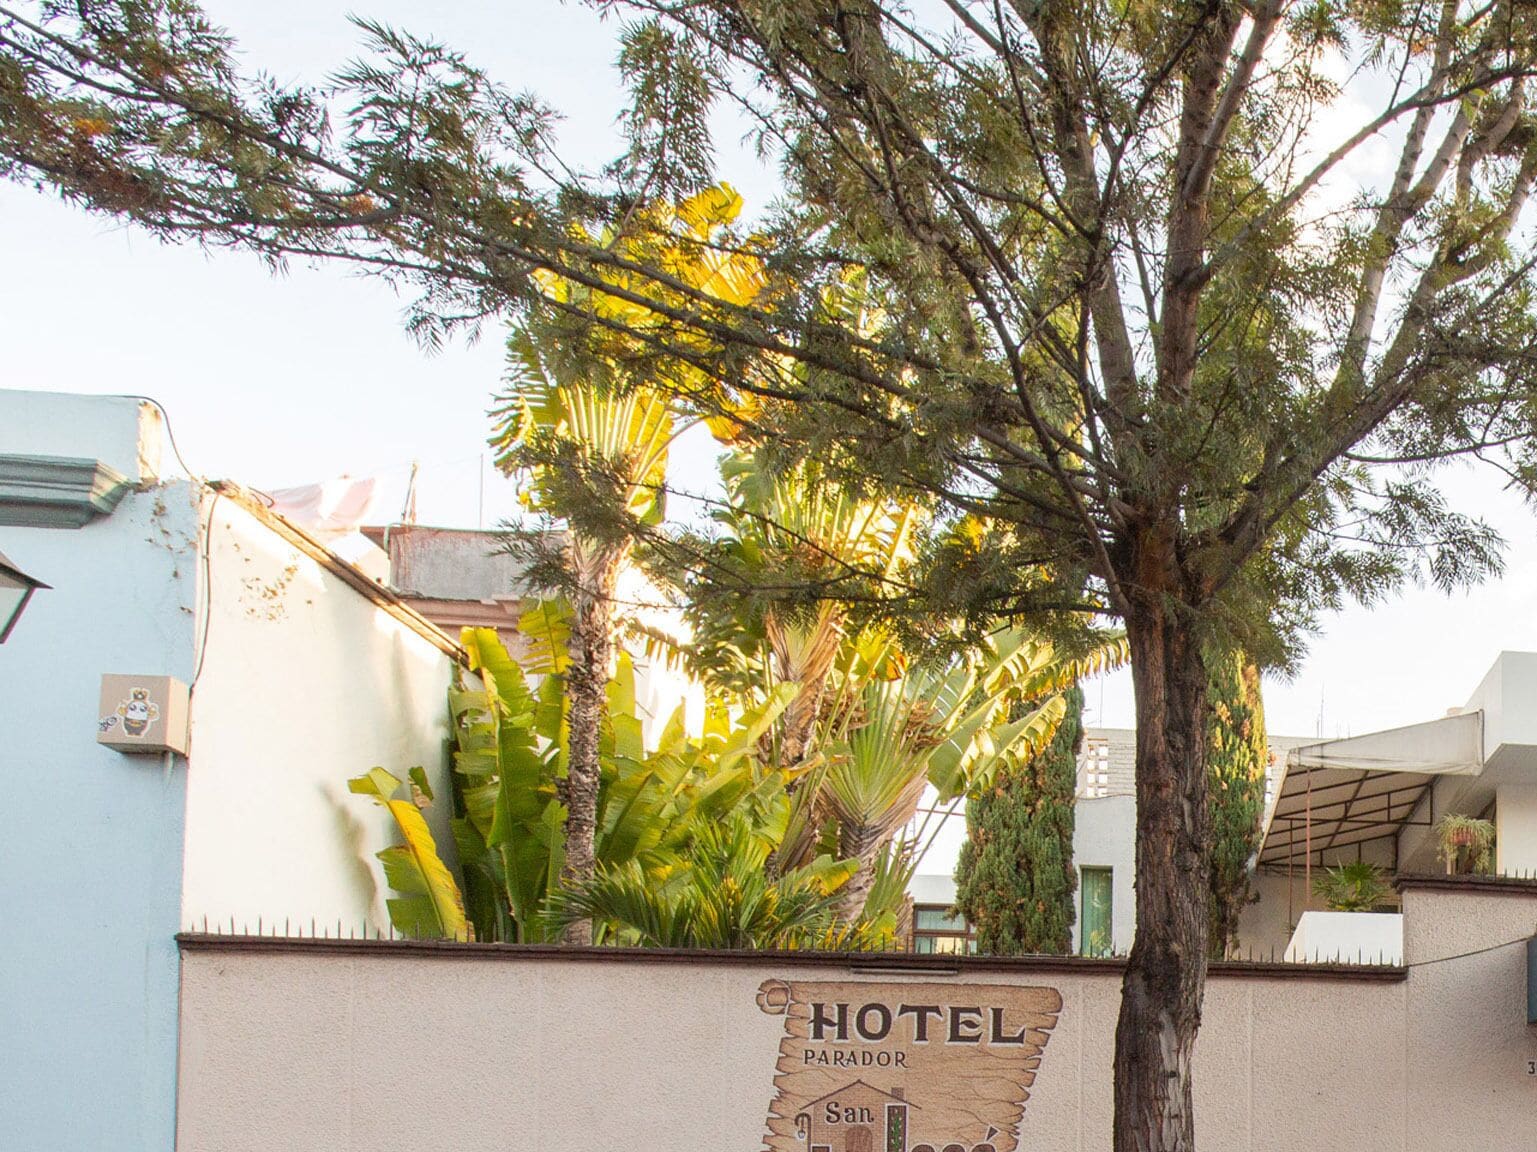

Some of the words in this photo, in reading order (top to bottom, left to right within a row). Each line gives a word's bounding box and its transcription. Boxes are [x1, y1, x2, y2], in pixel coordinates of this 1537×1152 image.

[808, 1002, 1026, 1044] HOTEL
[803, 1049, 909, 1068] PARADOR
[825, 1102, 875, 1124] San
